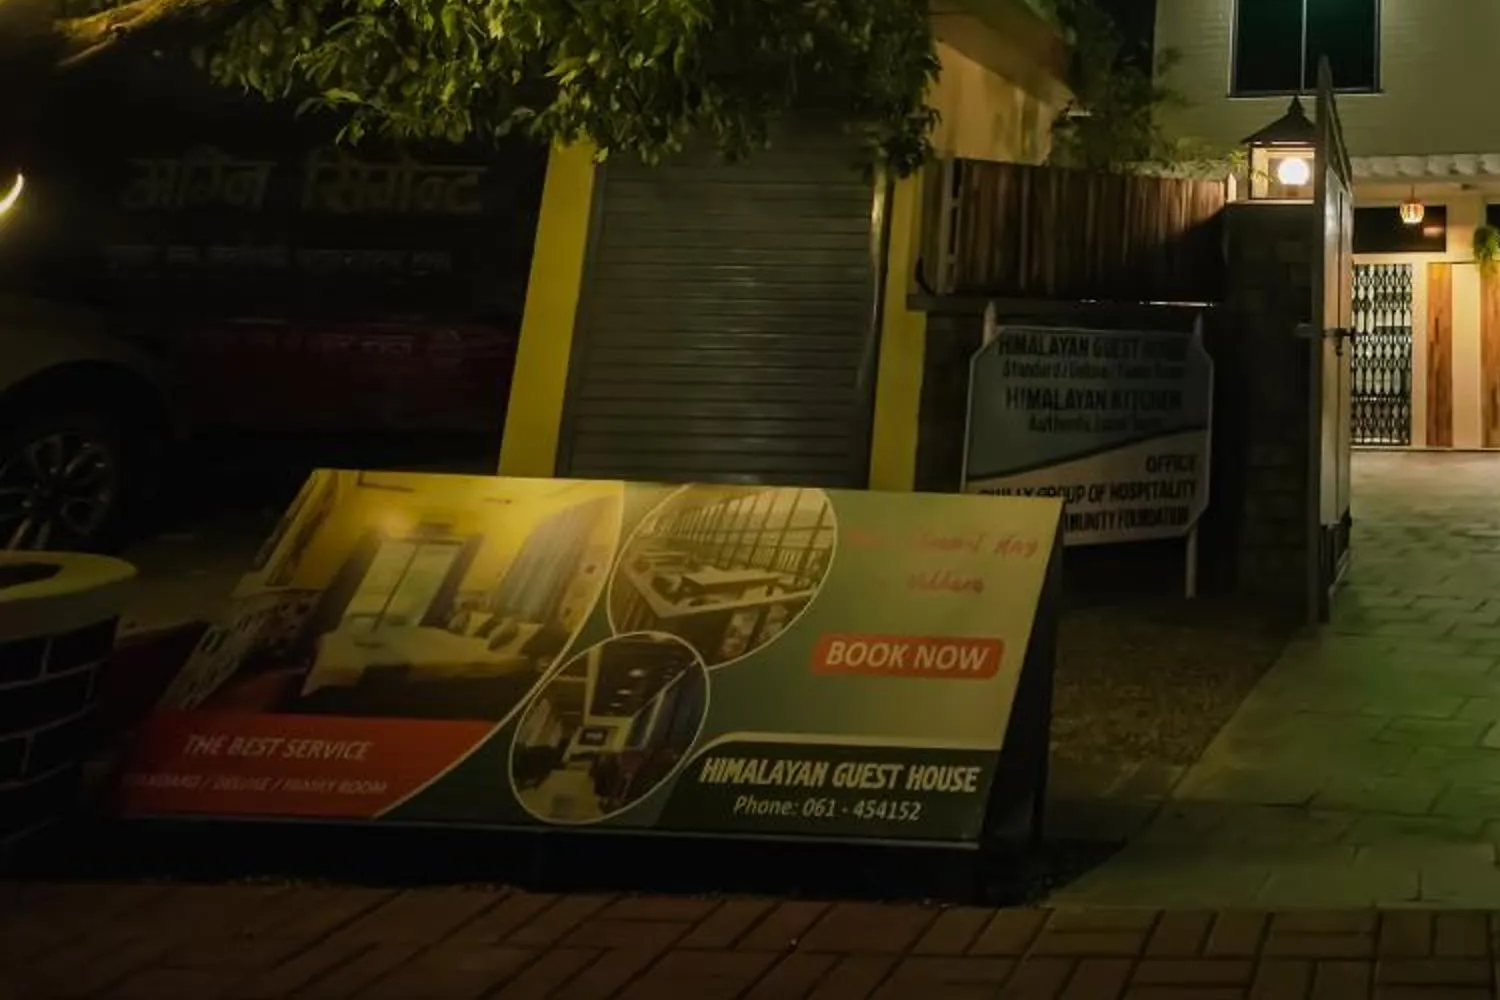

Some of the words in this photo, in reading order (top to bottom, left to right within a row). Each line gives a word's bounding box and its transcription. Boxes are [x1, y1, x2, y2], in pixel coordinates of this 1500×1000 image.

[998, 334, 1089, 357] HIMALAYAN
[1005, 387, 1107, 411] HIMALAYAN
[1145, 454, 1198, 474] OFFICE
[1088, 483, 1107, 502] OF
[1109, 478, 1196, 500] HOSPITALITY
[1118, 506, 1189, 530] FOUNDATION
[825, 640, 909, 667] BOOK
[912, 645, 991, 671] NOW
[183, 733, 227, 756] THE
[228, 735, 282, 758] BEST
[283, 739, 374, 761] SERVICE
[338, 780, 388, 795] ROOM
[700, 757, 830, 788] HIMALAYAN
[832, 763, 905, 791] GUEST
[905, 766, 984, 794] HOUSE
[734, 795, 801, 817] Phone:
[802, 798, 838, 818] 061
[852, 800, 923, 822] 454152
